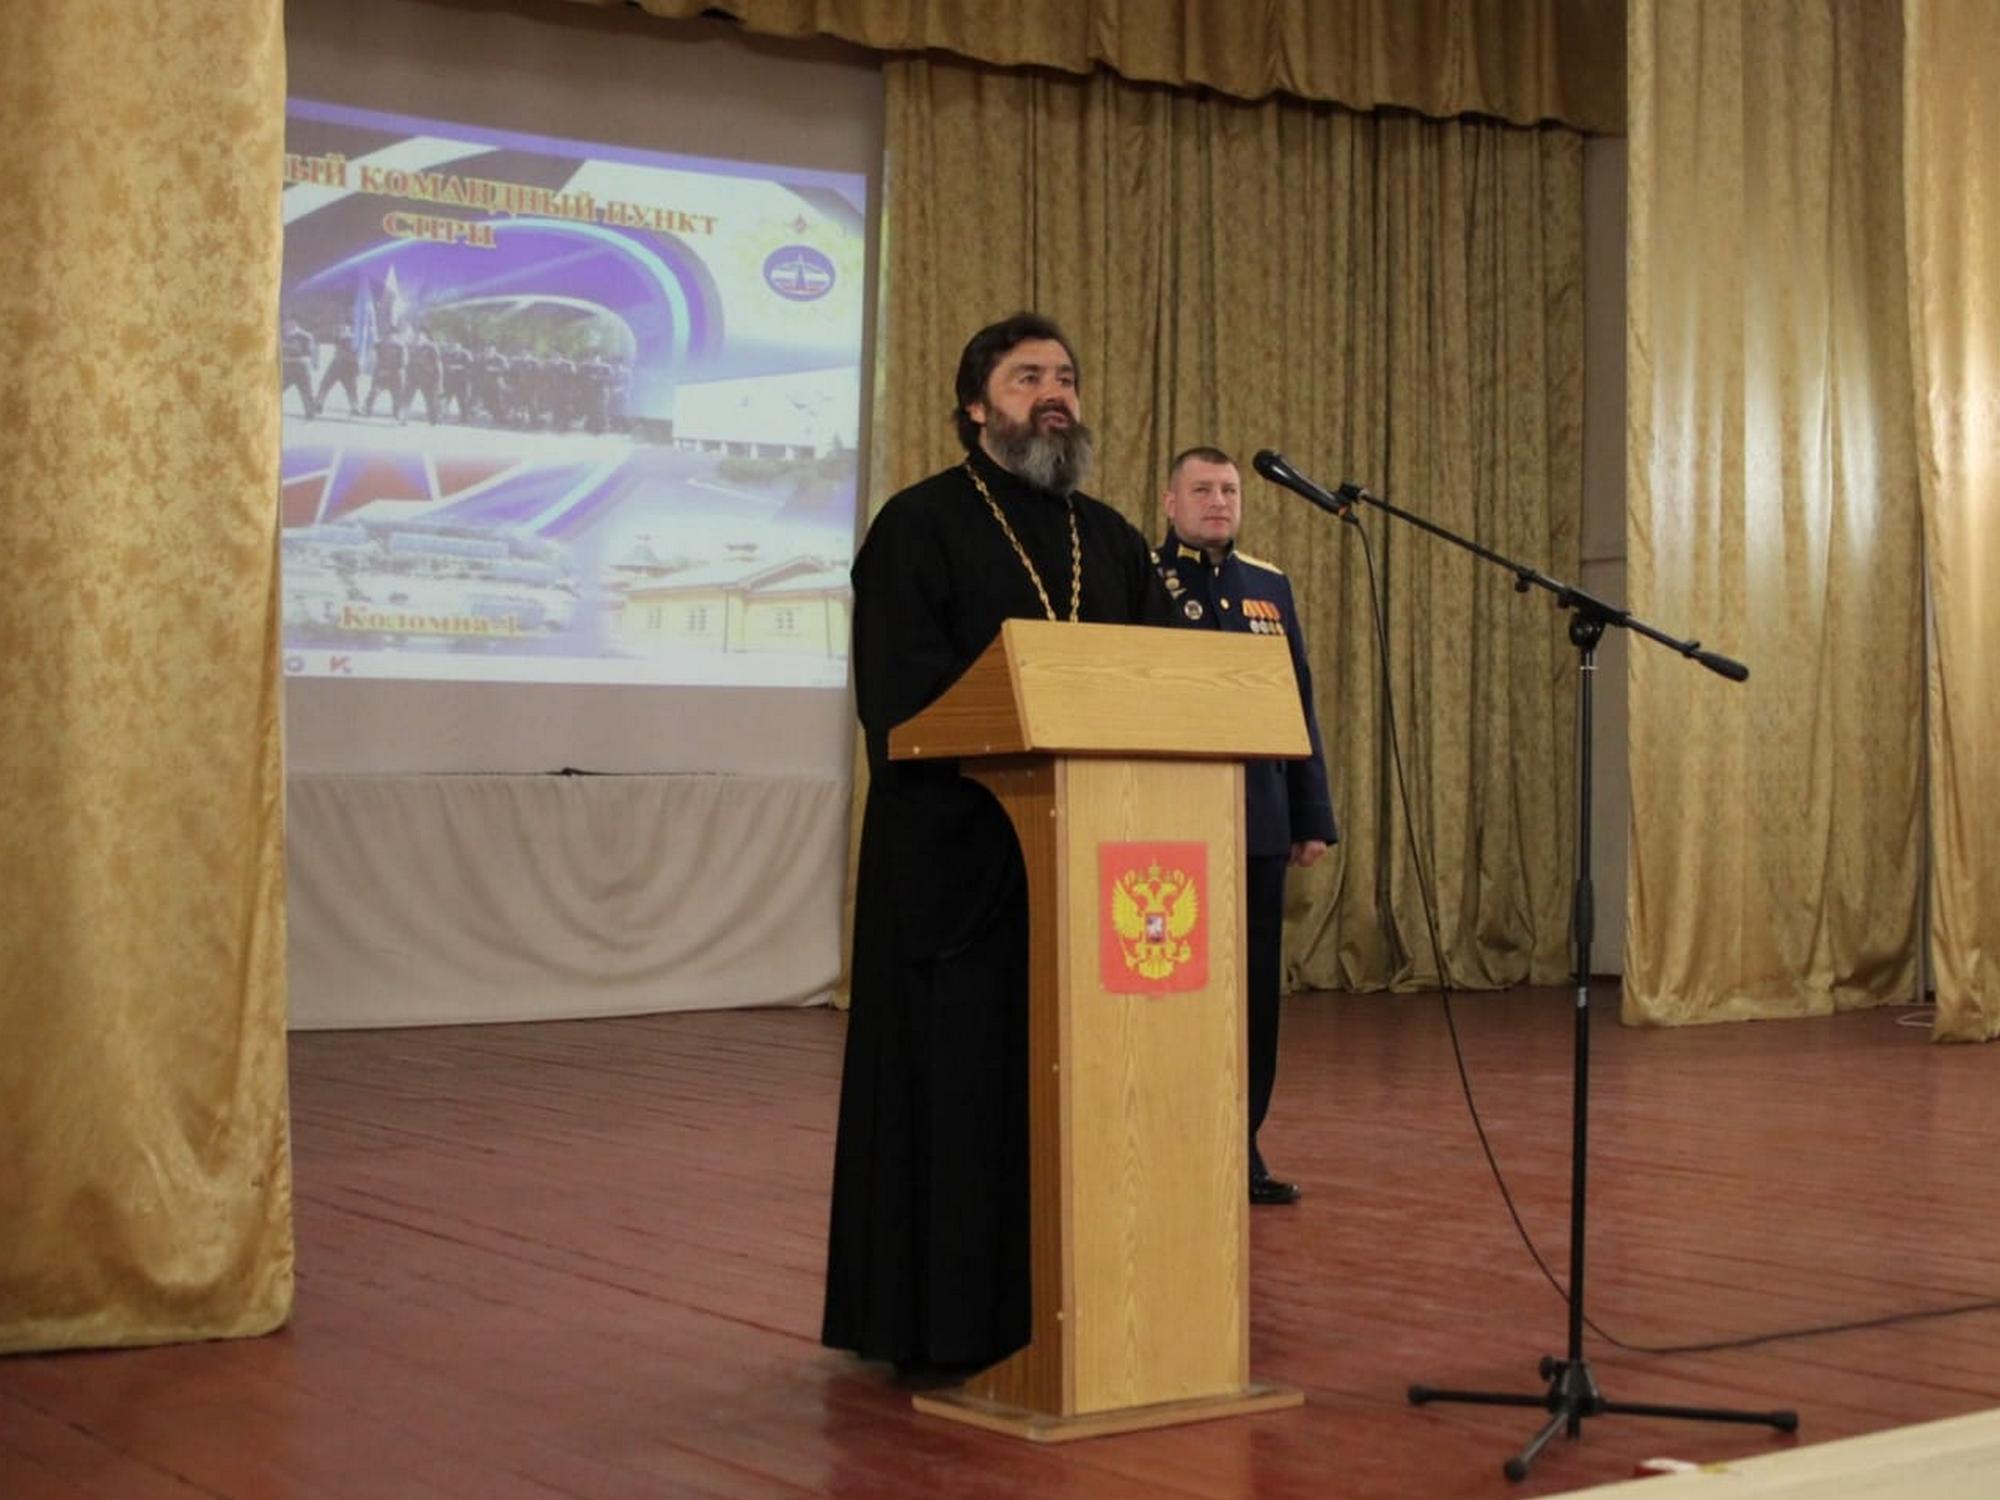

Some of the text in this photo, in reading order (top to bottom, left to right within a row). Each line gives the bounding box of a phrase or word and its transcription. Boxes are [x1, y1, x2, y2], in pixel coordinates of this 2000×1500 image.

[284, 152, 719, 235] ЫЙ КОМАНДНЫЙ ПУНКТ
